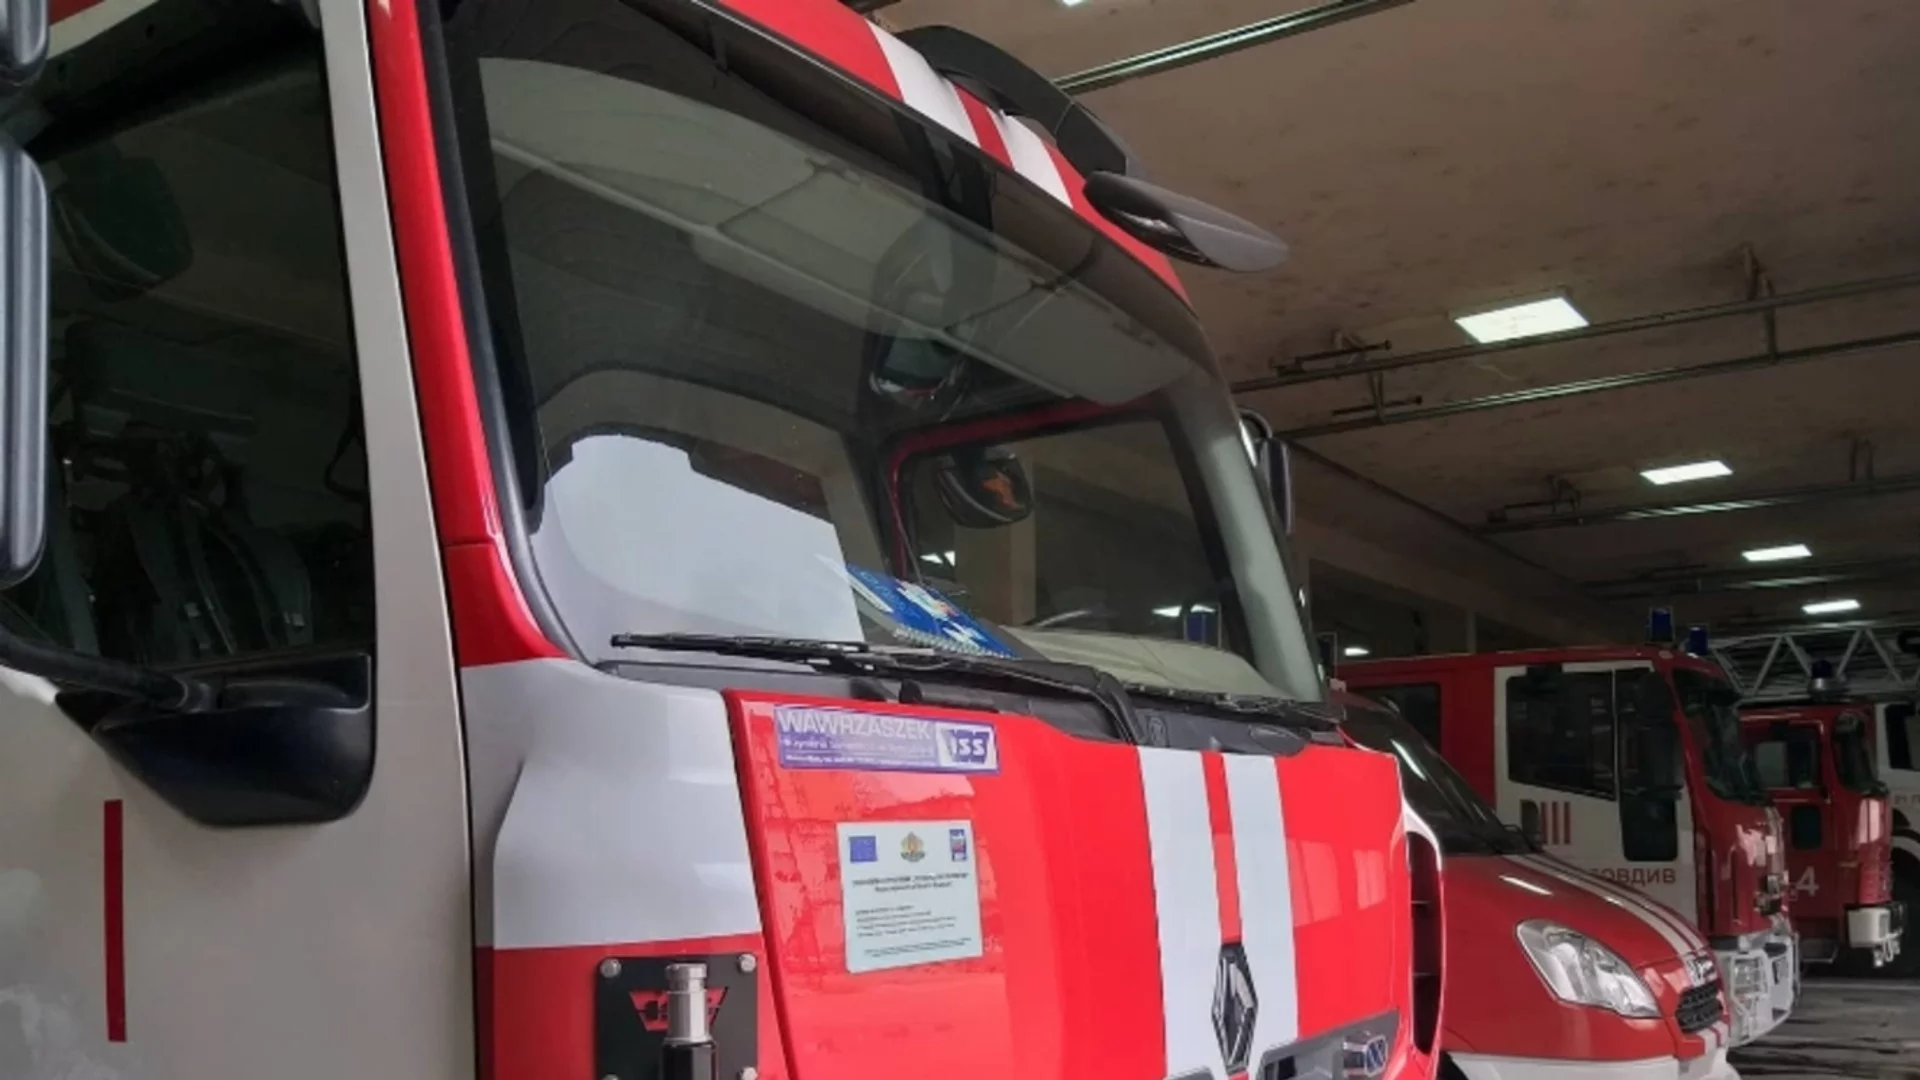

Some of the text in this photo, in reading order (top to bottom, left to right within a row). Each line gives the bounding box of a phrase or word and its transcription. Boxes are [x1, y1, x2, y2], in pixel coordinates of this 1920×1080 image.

[777, 709, 931, 740] WAWRZASZEK
[1590, 867, 1677, 887] ОВДИВ
[1795, 866, 1819, 897] 4
